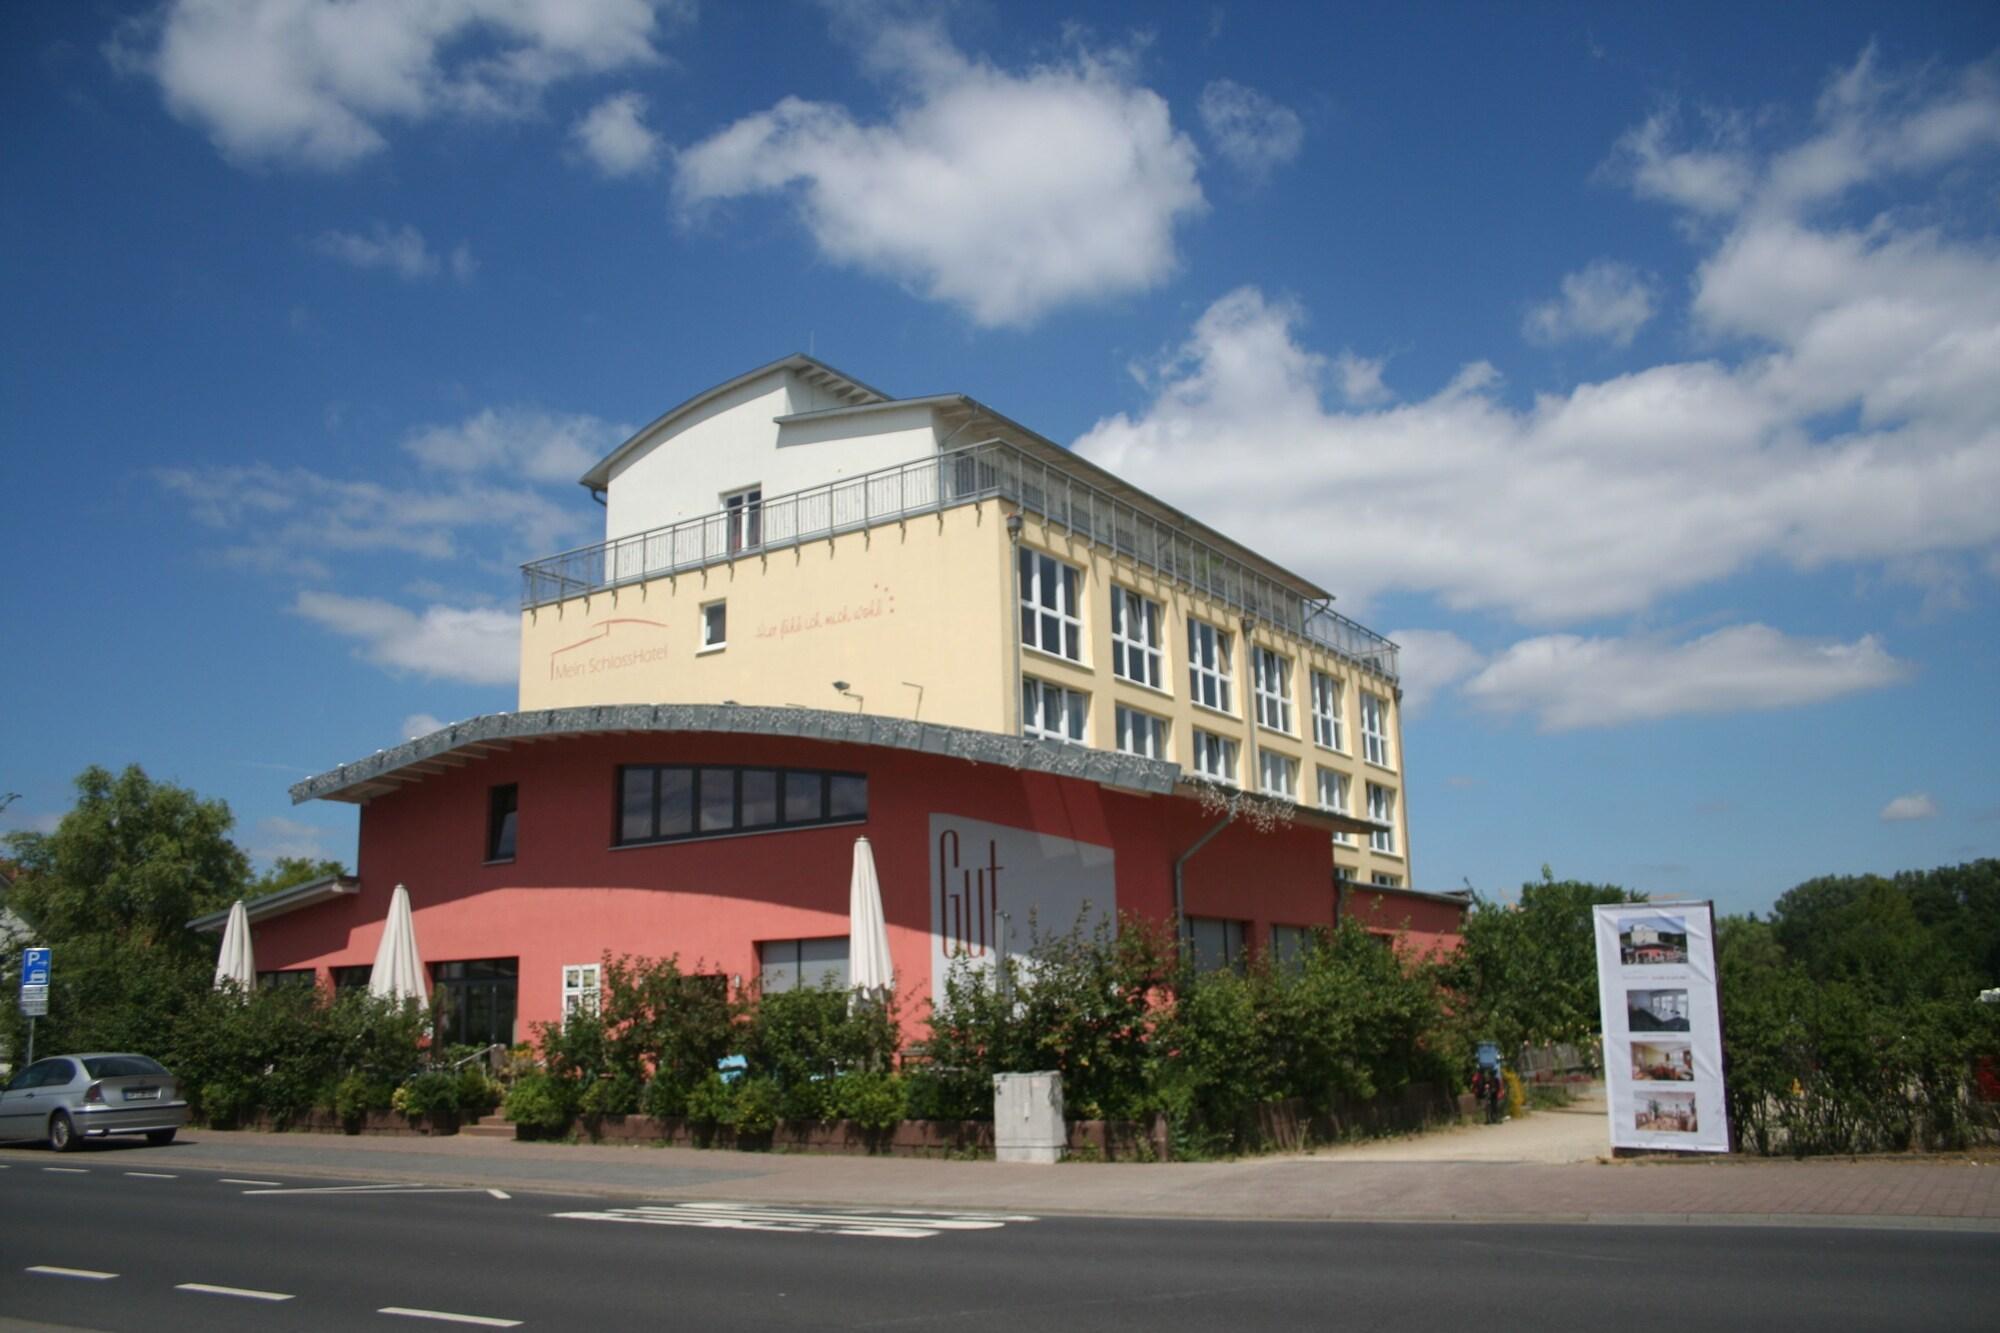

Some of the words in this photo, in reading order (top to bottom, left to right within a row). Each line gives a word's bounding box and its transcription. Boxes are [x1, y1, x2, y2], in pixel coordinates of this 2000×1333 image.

[555, 663, 585, 680] Mein
[589, 643, 668, 673] SchlossHotel
[940, 829, 1005, 959] Gut
[28, 951, 41, 967] P
